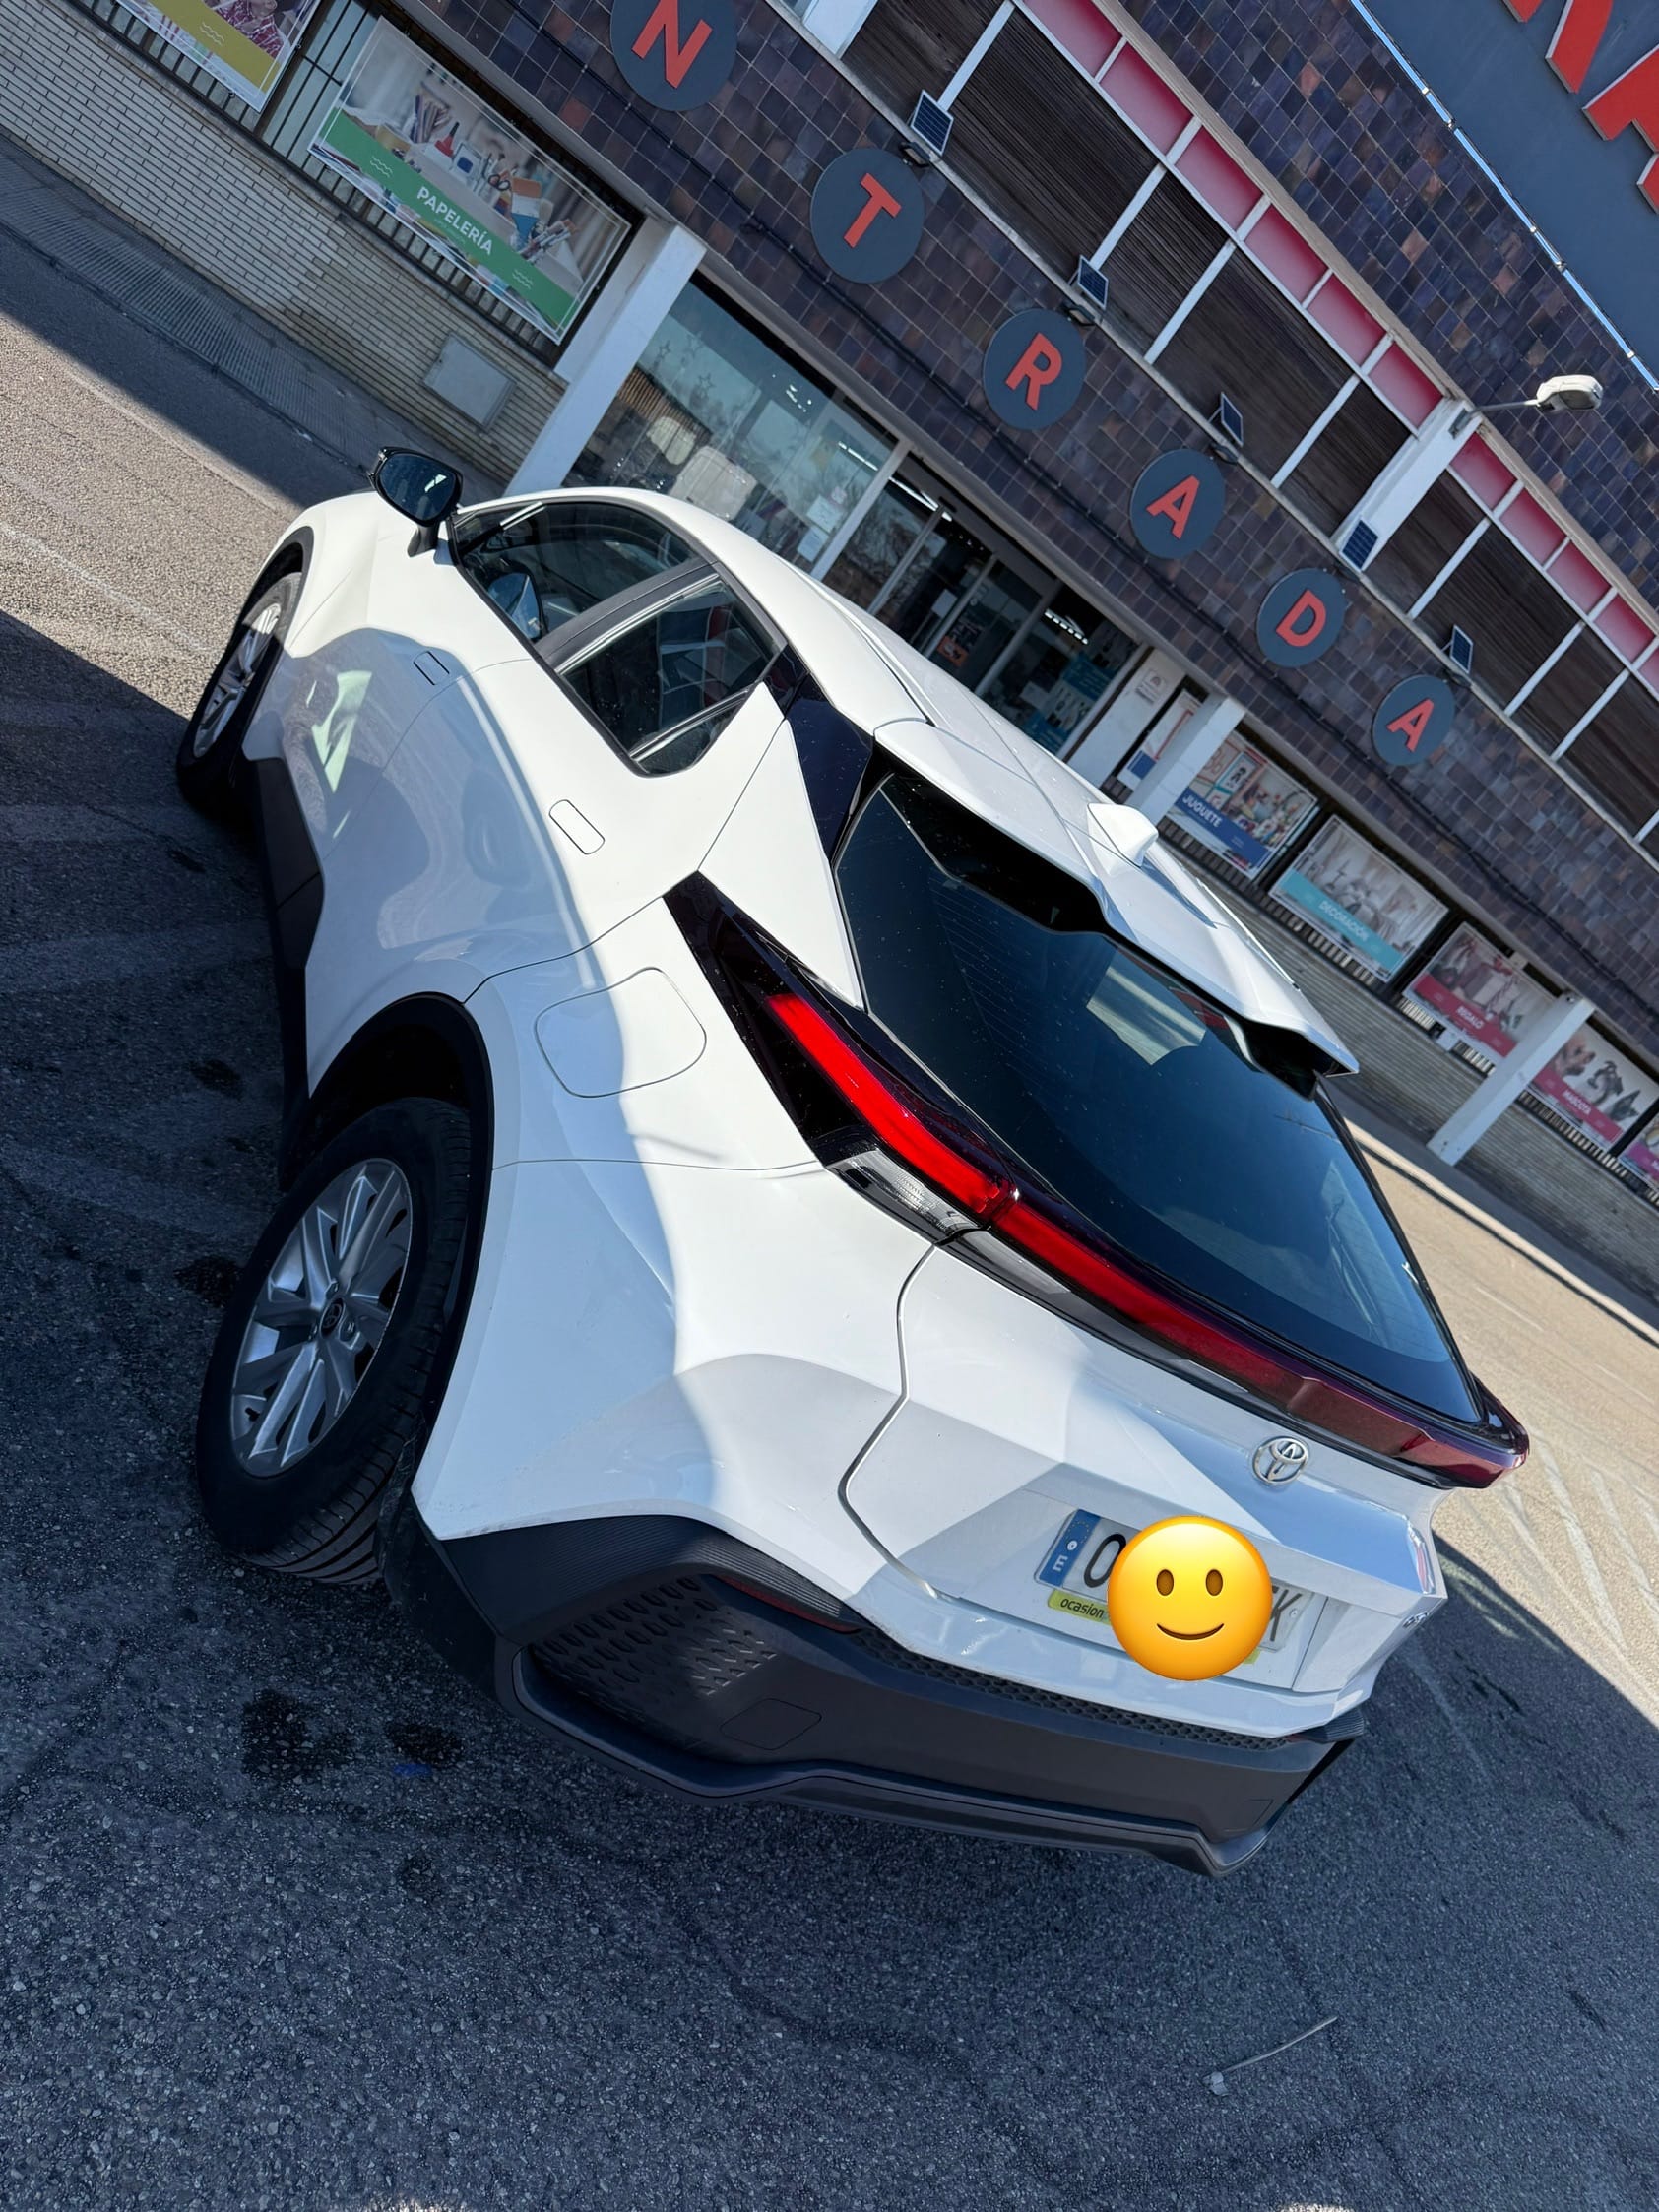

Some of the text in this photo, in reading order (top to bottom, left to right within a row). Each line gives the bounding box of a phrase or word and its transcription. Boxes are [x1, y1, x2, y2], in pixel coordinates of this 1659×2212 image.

[416, 186, 492, 255] PAPELERÍA
[1182, 790, 1223, 828] JUGUETE
[1318, 900, 1370, 942] DECORACIÓN
[1456, 1005, 1485, 1029] REGALO
[1562, 1089, 1592, 1115] MASCOTA
[1060, 1598, 1105, 1618] ocasion
